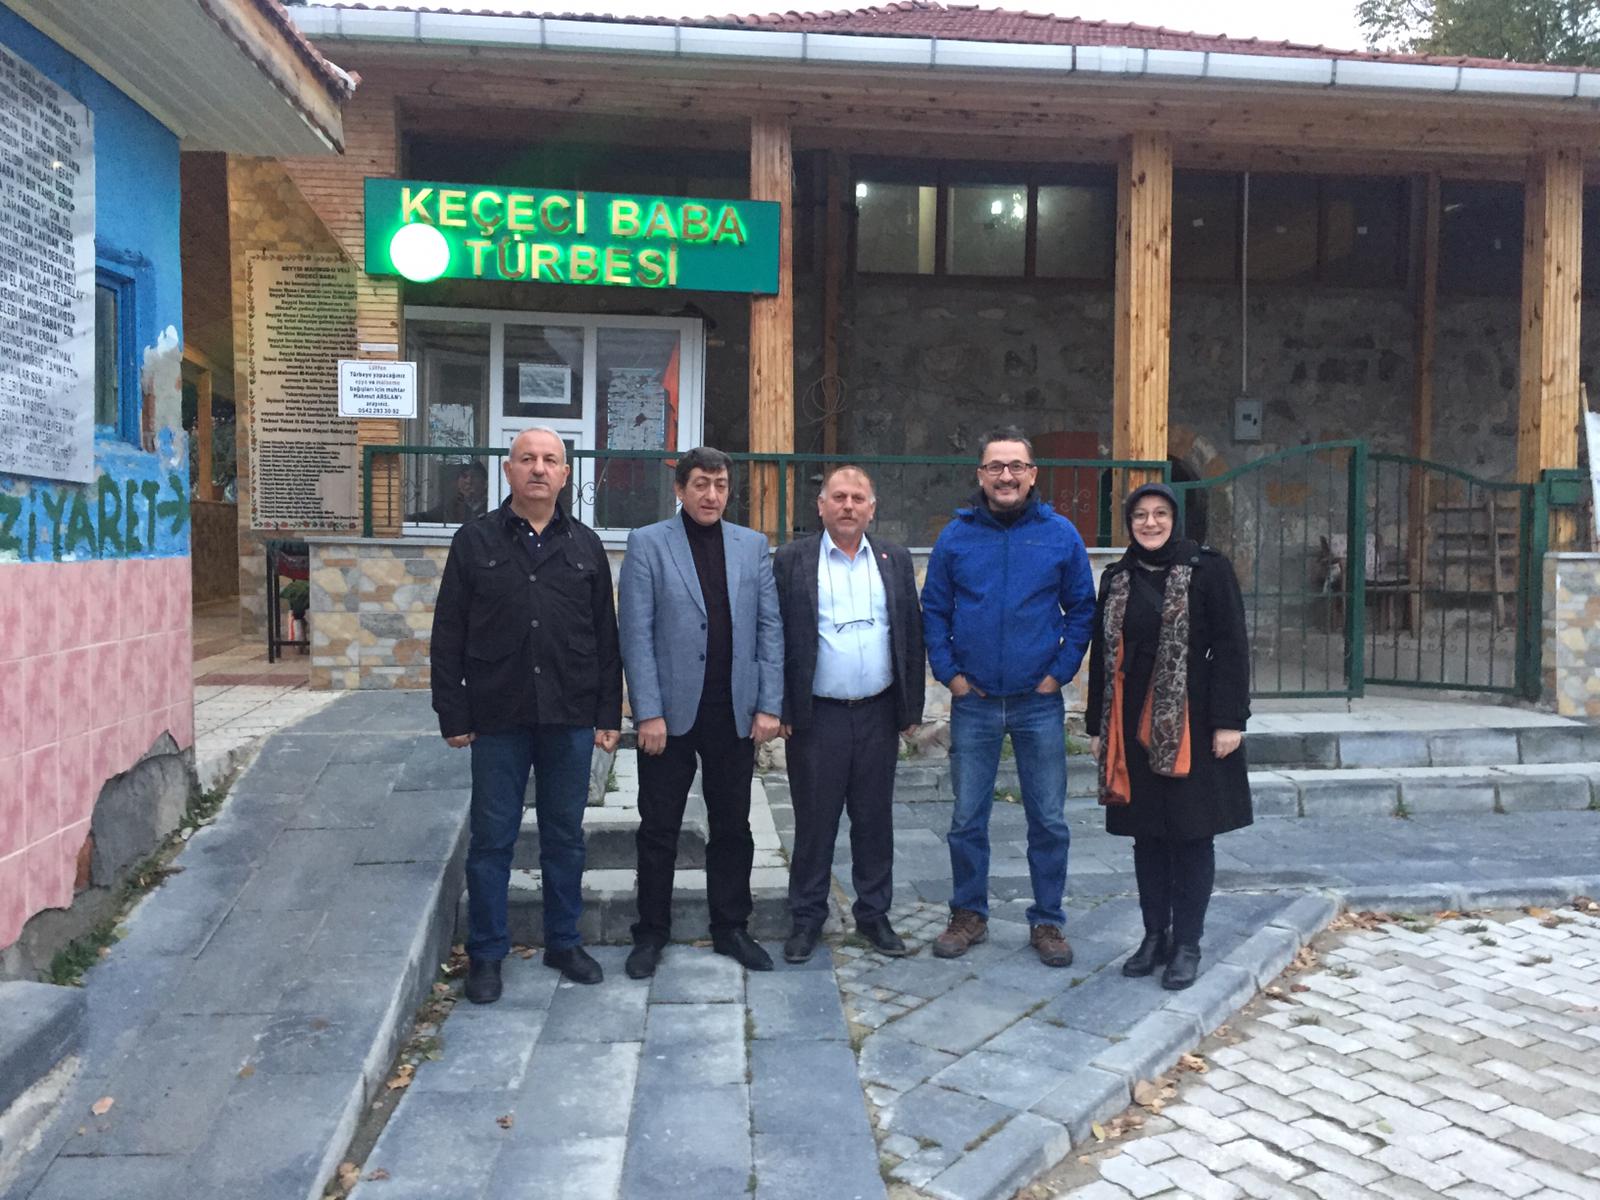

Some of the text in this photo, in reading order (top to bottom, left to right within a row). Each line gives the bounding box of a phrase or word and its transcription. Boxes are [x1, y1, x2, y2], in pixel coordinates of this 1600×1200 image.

[401, 186, 746, 245] KEÇECİ BABA
[463, 233, 678, 287] TÜRBESİ
